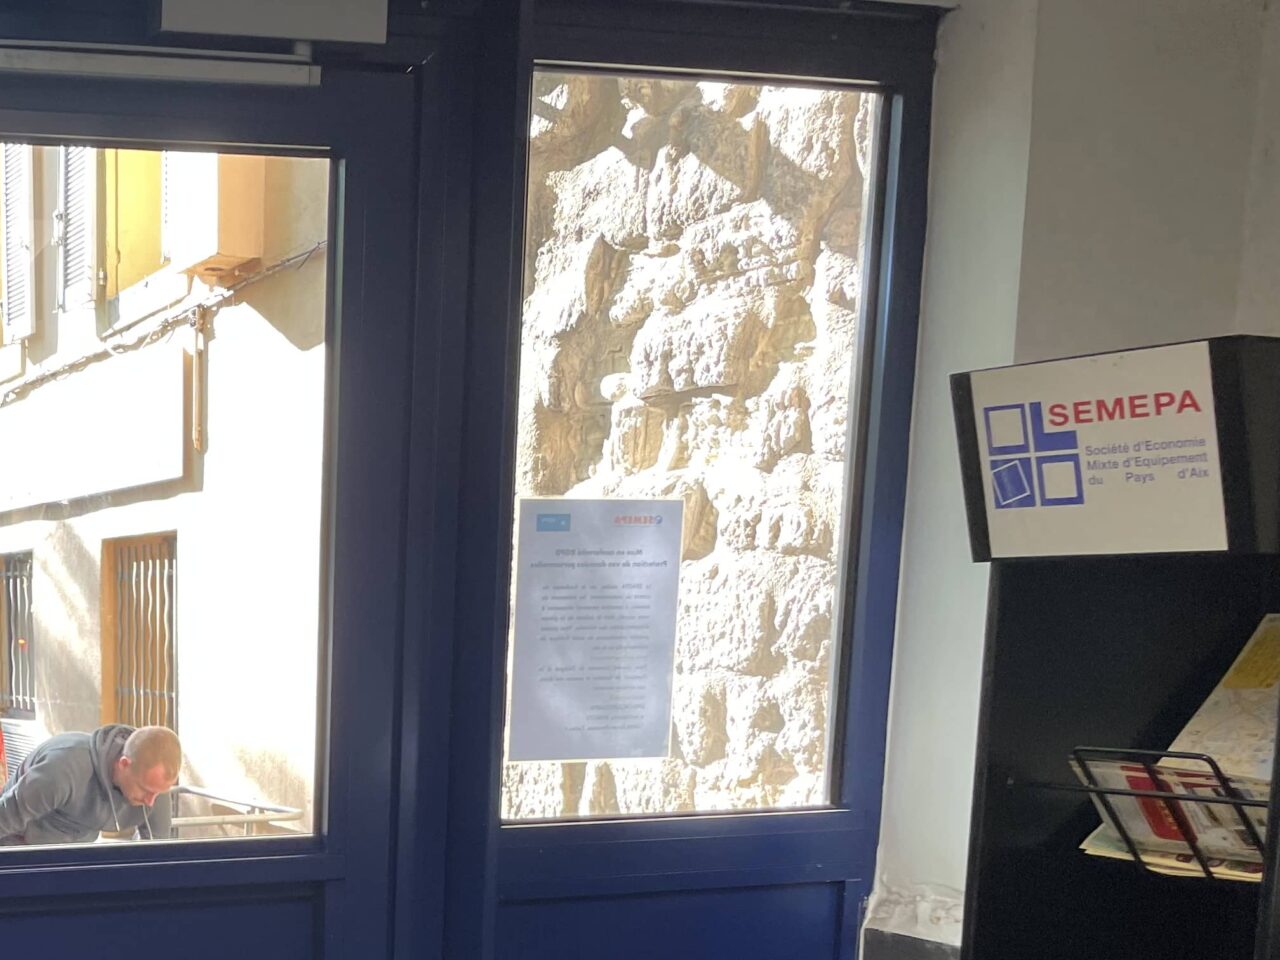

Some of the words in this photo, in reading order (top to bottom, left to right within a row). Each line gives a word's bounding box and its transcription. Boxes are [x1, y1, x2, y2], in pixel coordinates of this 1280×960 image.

[1048, 390, 1202, 426] SEMEPA
[1085, 443, 1129, 456] Société
[1133, 437, 1206, 452] d'Economie
[1087, 459, 1119, 470] Mixte
[1123, 453, 1208, 468] d'Equipement
[1088, 475, 1103, 486] du
[1125, 472, 1155, 484] Pays
[1177, 468, 1209, 479] d'Aix
